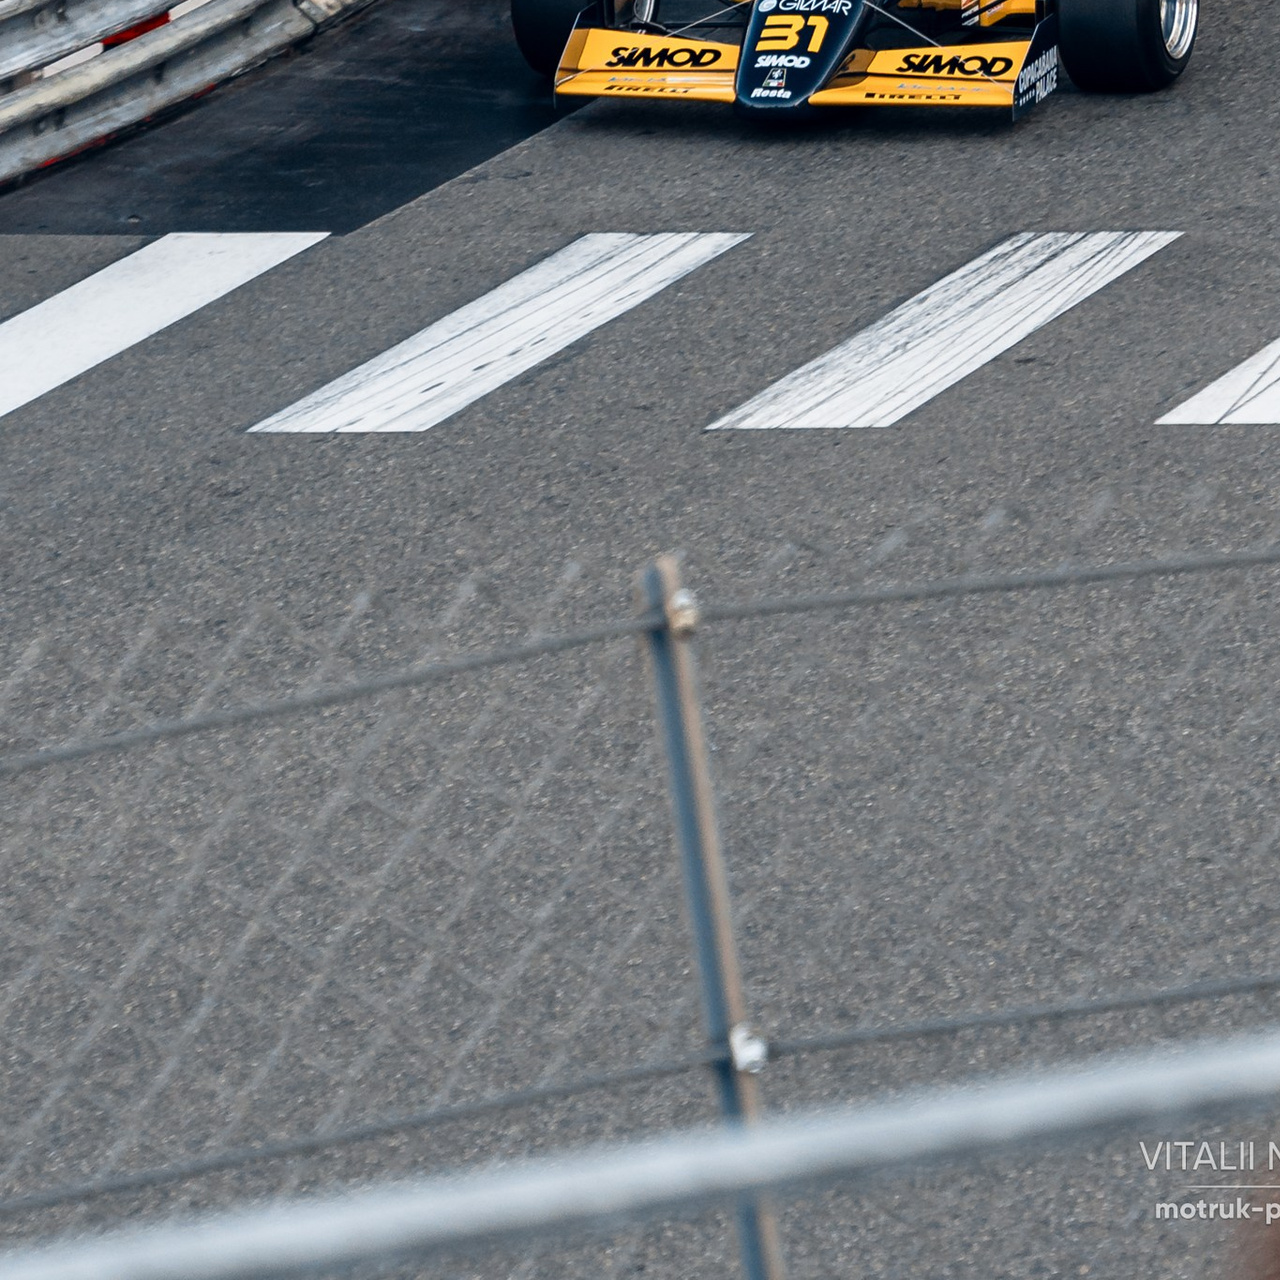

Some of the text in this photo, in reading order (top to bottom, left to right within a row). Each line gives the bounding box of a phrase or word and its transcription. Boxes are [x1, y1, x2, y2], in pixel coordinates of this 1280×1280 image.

[755, 14, 829, 53] 31
[605, 47, 722, 68] SIMOD
[754, 55, 810, 68] SIMOD
[896, 54, 1013, 77] SIMOD
[1018, 45, 1058, 94] COPACABANA
[1035, 68, 1058, 104] PALACE
